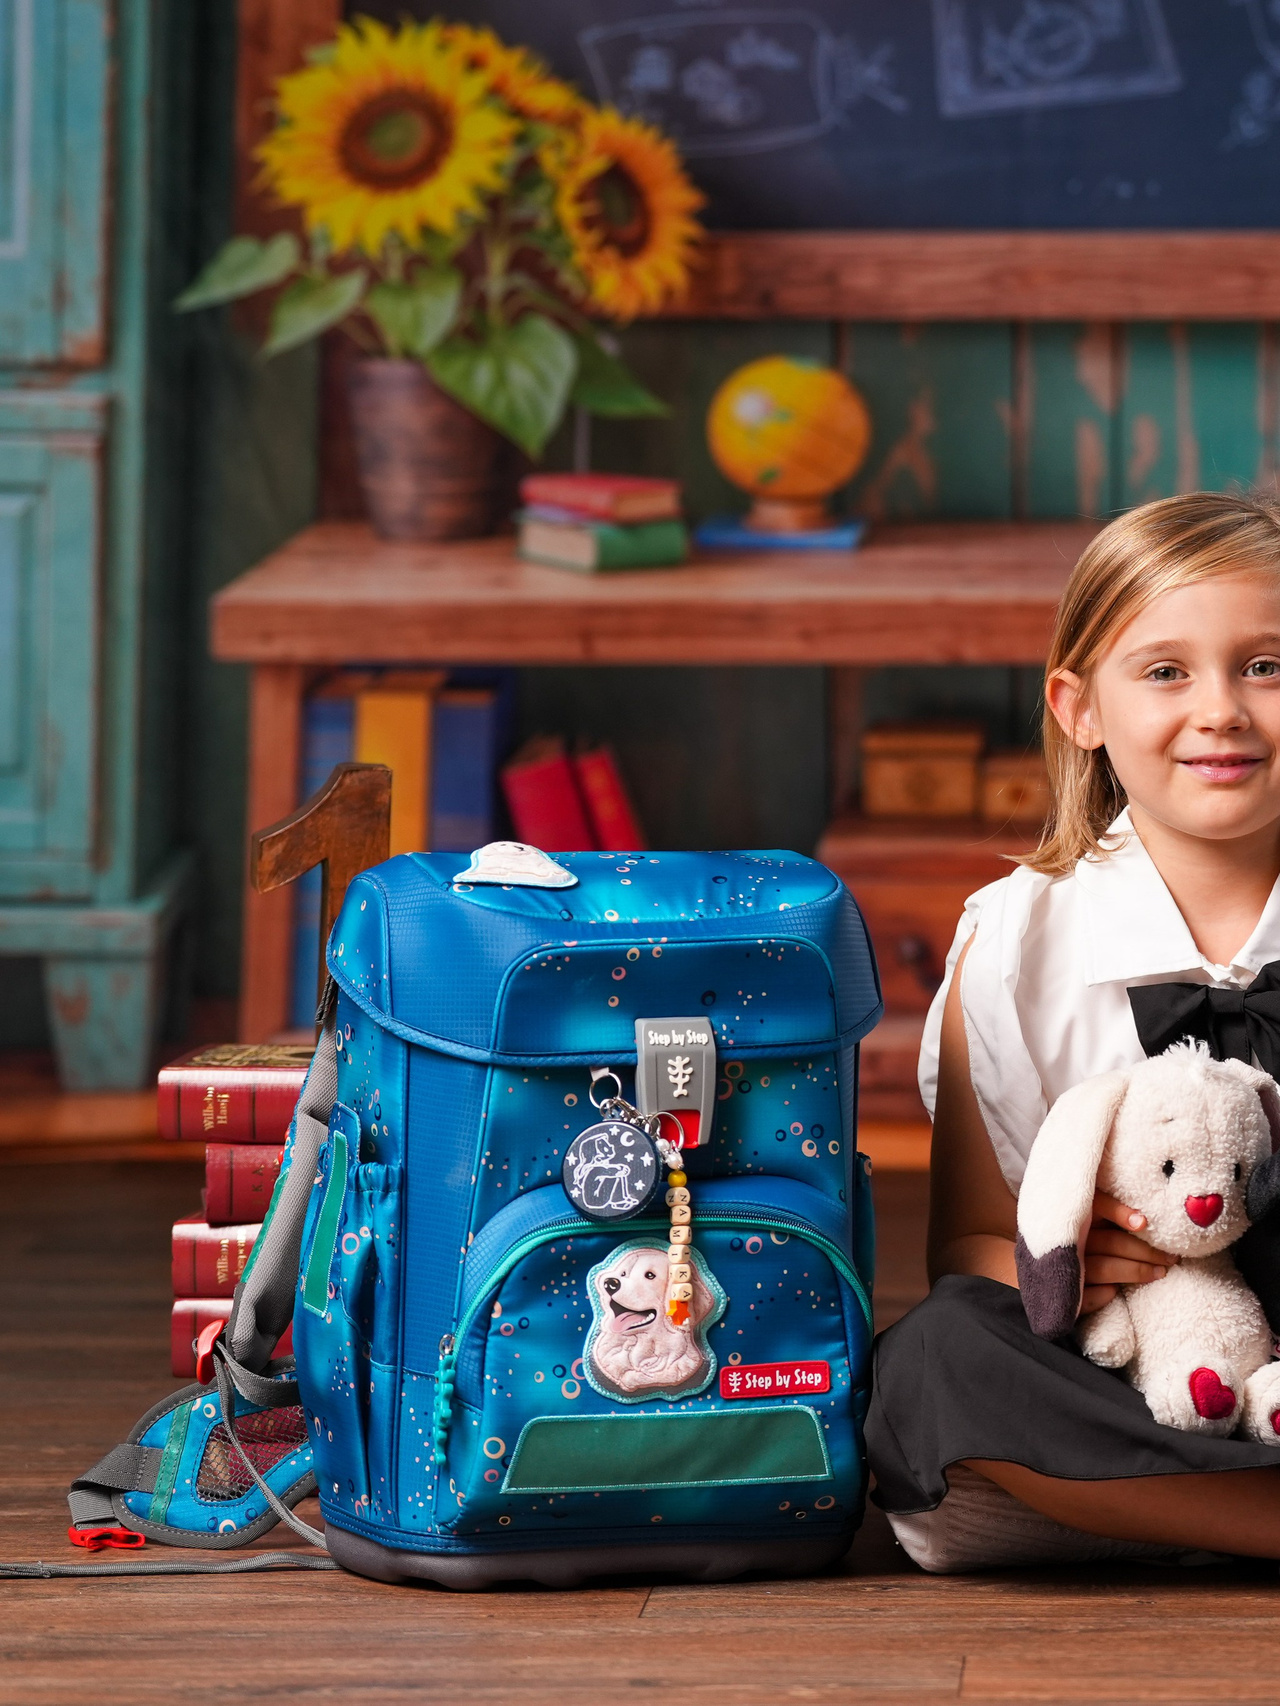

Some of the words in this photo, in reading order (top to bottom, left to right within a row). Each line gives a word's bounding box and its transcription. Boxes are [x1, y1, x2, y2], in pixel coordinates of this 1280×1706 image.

[648, 1030, 671, 1046] Step
[671, 1029, 685, 1046] by
[686, 1029, 709, 1046] Step
[745, 1372, 773, 1390] Step
[775, 1369, 791, 1388] by
[794, 1368, 822, 1387] Step
